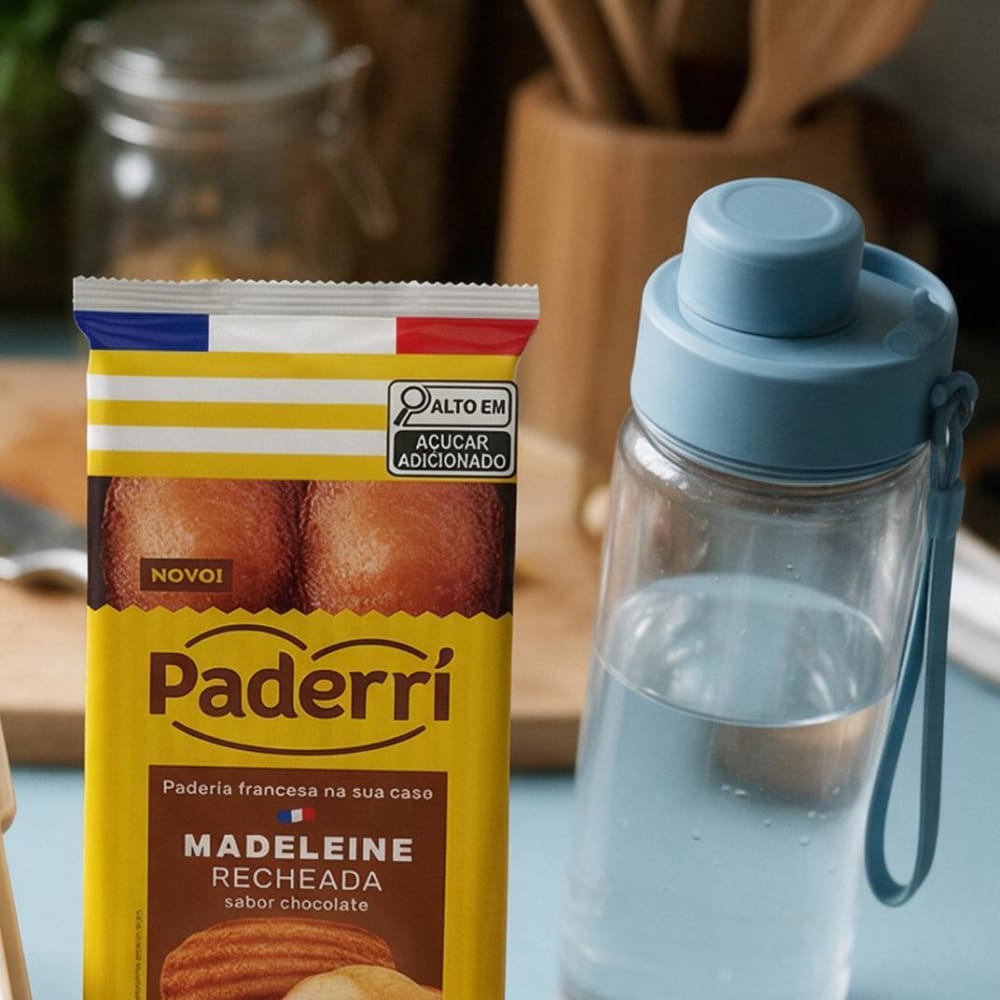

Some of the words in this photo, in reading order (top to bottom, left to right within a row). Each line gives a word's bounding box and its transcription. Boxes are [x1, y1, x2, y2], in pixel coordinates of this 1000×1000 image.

[430, 399, 477, 415] ALTO
[480, 399, 506, 415] EM
[149, 647, 455, 721] Paderrí
[162, 780, 233, 796] Paderia
[238, 782, 318, 799] francesa
[325, 787, 348, 800] na
[353, 787, 386, 801] sua
[184, 834, 413, 862] MADELEINE
[211, 868, 383, 891] RECHEADA
[224, 896, 275, 911] sabor
[280, 897, 370, 914] chocolate
